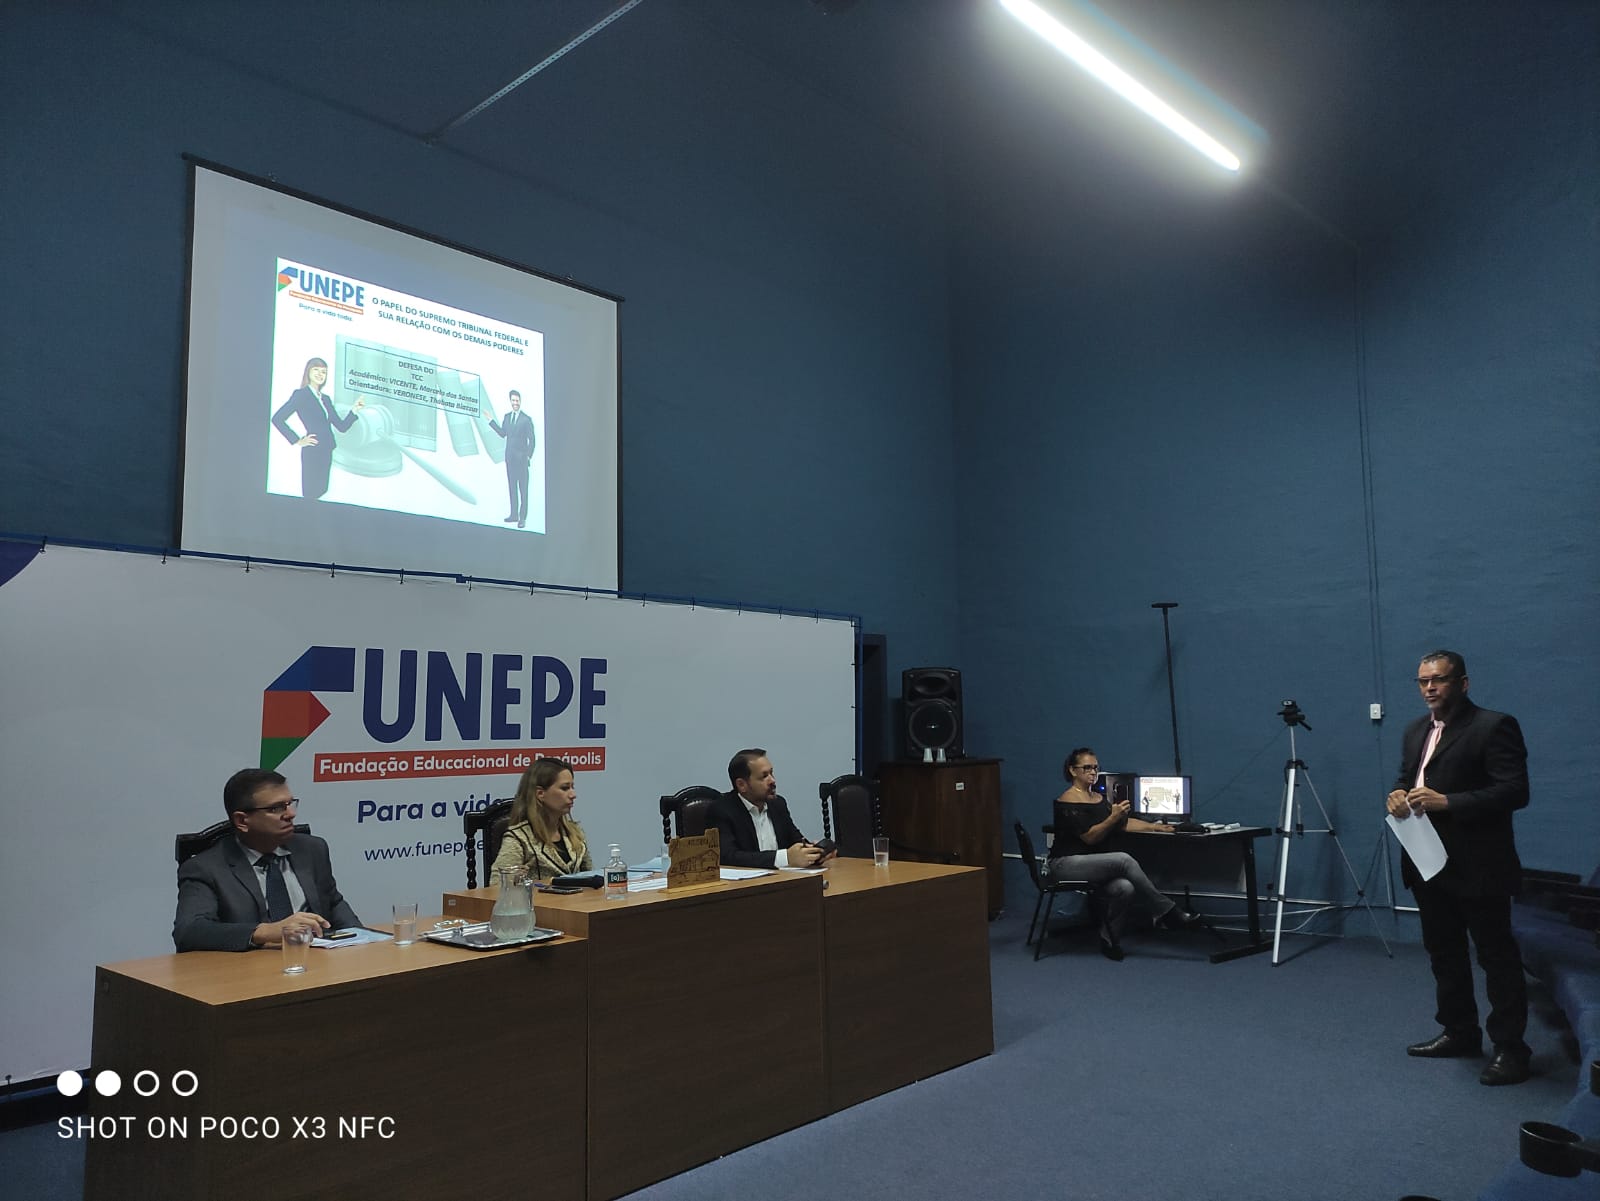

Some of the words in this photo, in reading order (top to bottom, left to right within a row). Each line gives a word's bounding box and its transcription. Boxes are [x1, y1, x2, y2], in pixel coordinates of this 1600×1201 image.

[372, 297, 379, 305] O
[380, 299, 404, 312] PAPEL
[405, 306, 418, 316] DO
[419, 310, 456, 327] SUPREMO
[458, 321, 493, 337] TRIBUNAL
[494, 331, 524, 346] FEDERAL
[524, 339, 529, 347] E
[378, 310, 394, 321] SUA
[396, 315, 431, 330] RELAÇÃO
[432, 325, 451, 337] COM
[452, 330, 462, 340] OS
[463, 333, 492, 347] DEMAIS
[492, 341, 524, 356] PODERES
[398, 360, 423, 373] DEFESA
[423, 366, 434, 375] DO
[411, 373, 424, 382] TCC
[319, 757, 409, 777] Fundação
[413, 754, 509, 771] Educacional
[512, 753, 531, 768] de
[357, 799, 424, 824] Para
[431, 801, 447, 818] a
[453, 793, 504, 817] vid
